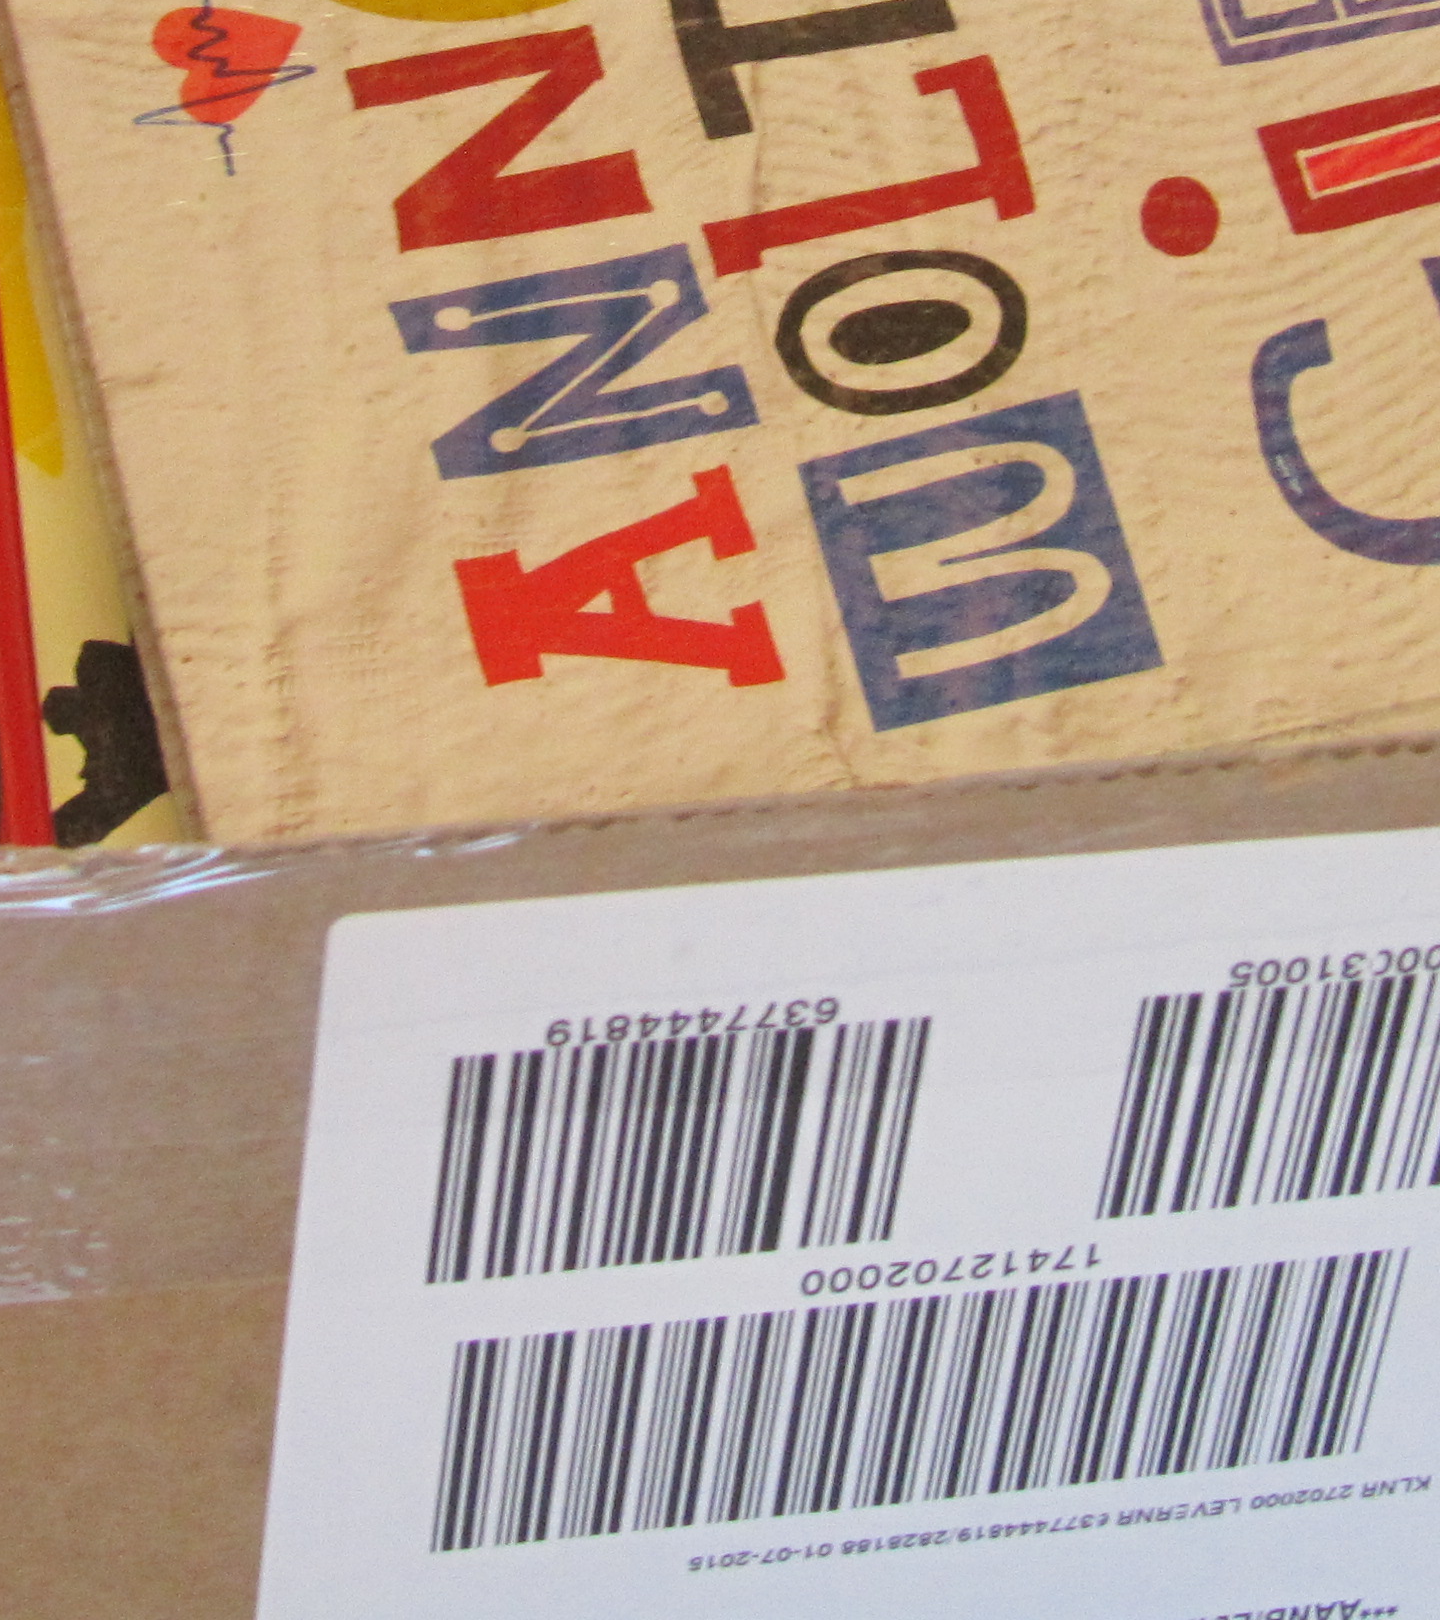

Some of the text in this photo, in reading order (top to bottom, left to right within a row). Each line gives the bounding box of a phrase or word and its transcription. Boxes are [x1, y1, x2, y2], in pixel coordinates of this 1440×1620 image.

[546, 996, 840, 1047] 6377444819
[801, 1243, 1101, 1296] 17412702000
[1250, 1482, 1355, 1511] 2702000
[1360, 1474, 1433, 1500] KLNR
